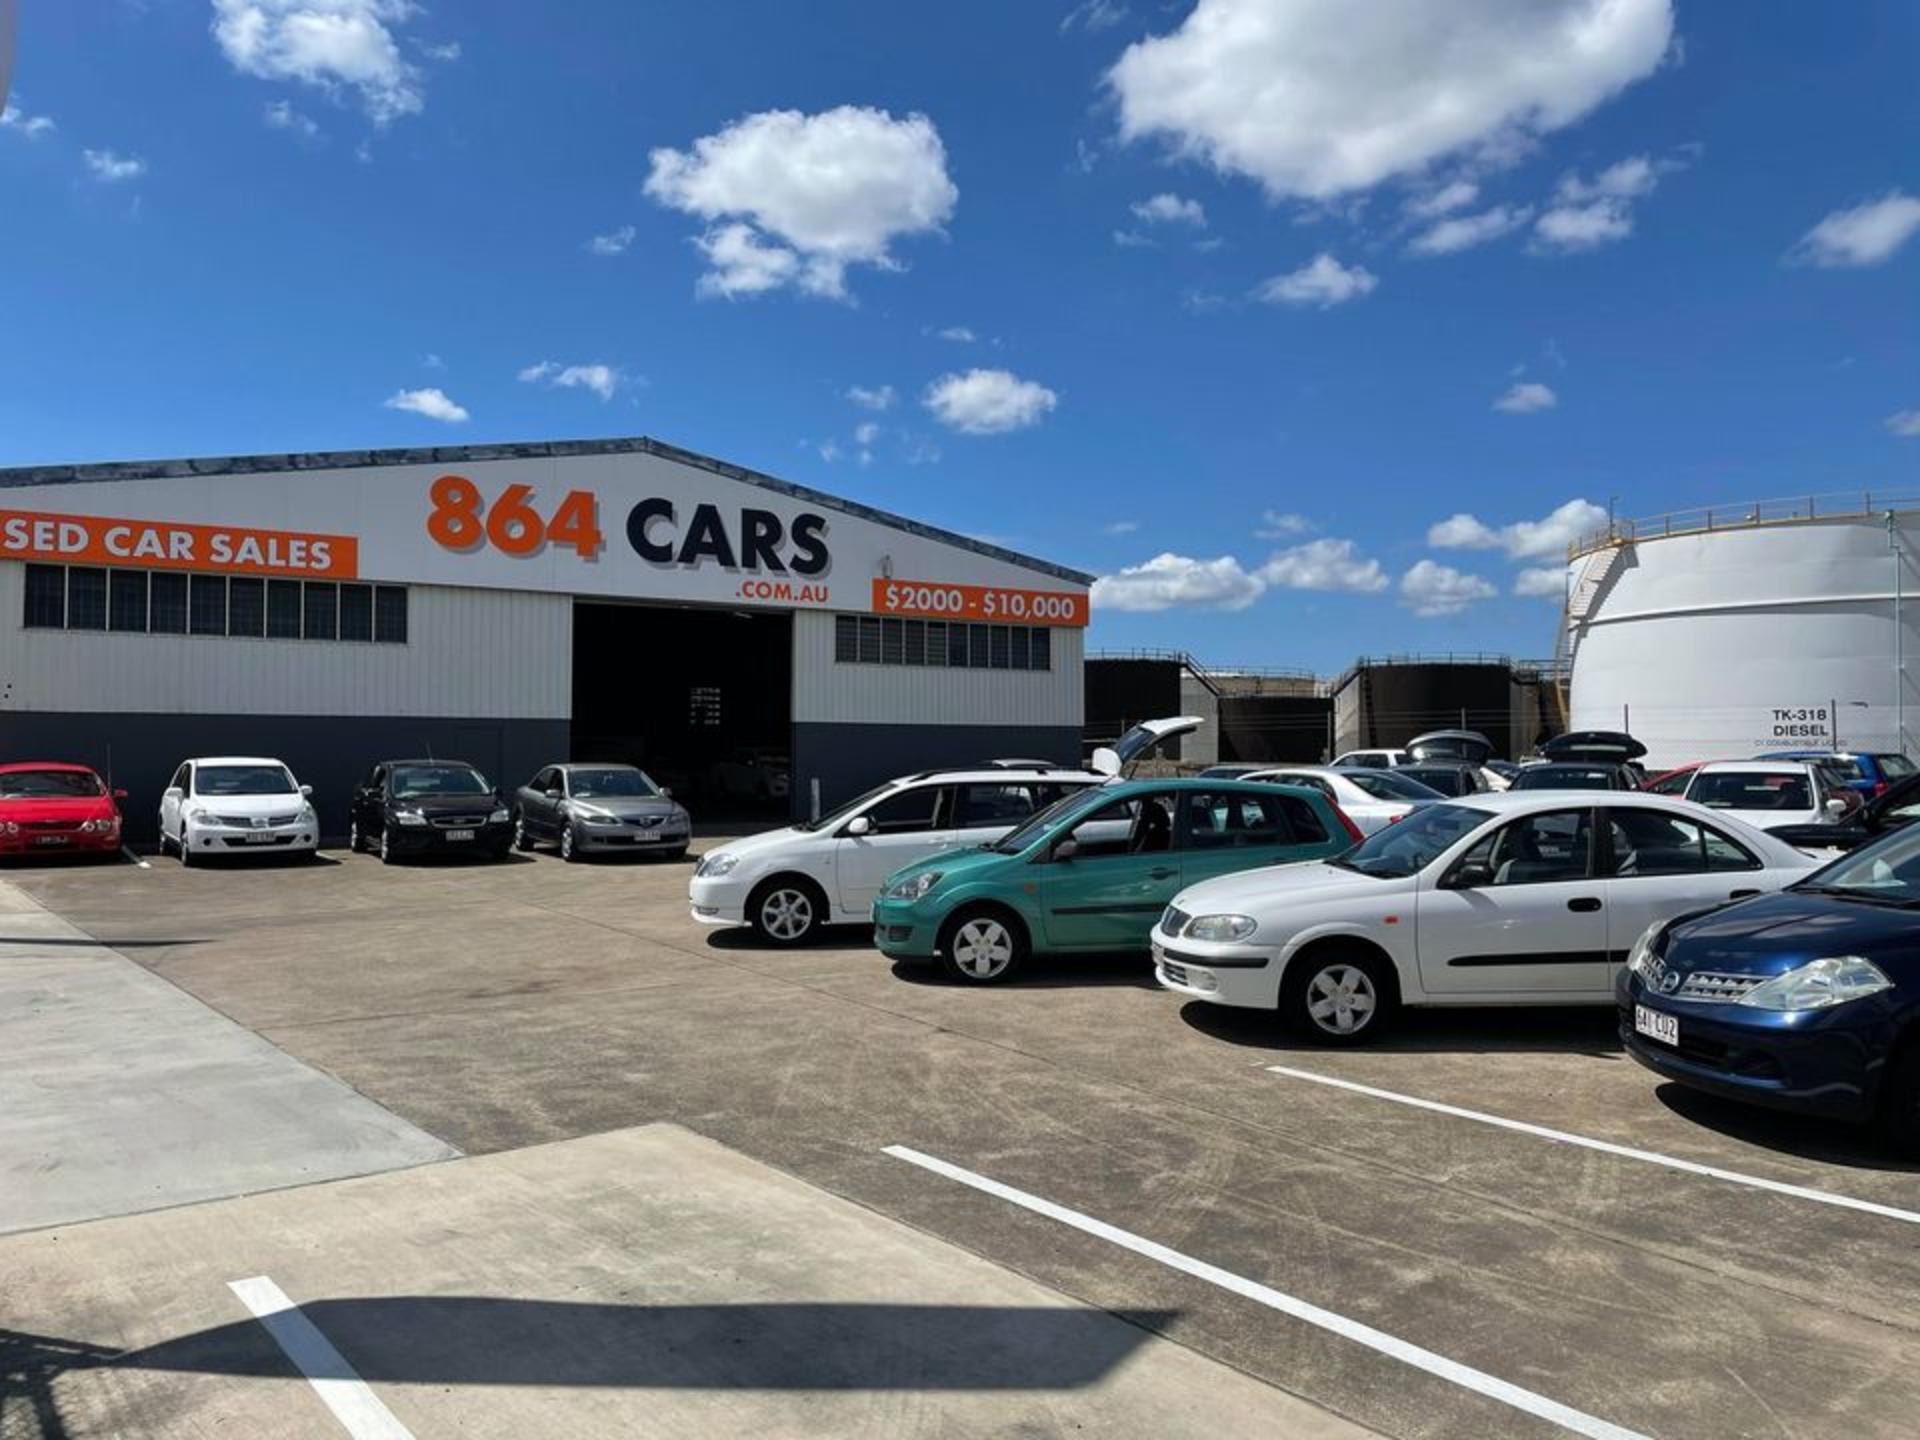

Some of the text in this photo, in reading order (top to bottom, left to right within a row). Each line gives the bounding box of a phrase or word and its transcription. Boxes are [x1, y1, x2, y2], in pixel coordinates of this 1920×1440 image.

[427, 475, 831, 578] 864 CARS
[3, 518, 332, 570] SED CAR SALES
[735, 580, 828, 602] .COM.AU
[885, 583, 963, 612] $2000
[983, 591, 1075, 620] $10,000
[1772, 708, 1827, 721] TK-318
[1773, 724, 1829, 737] DIESEL
